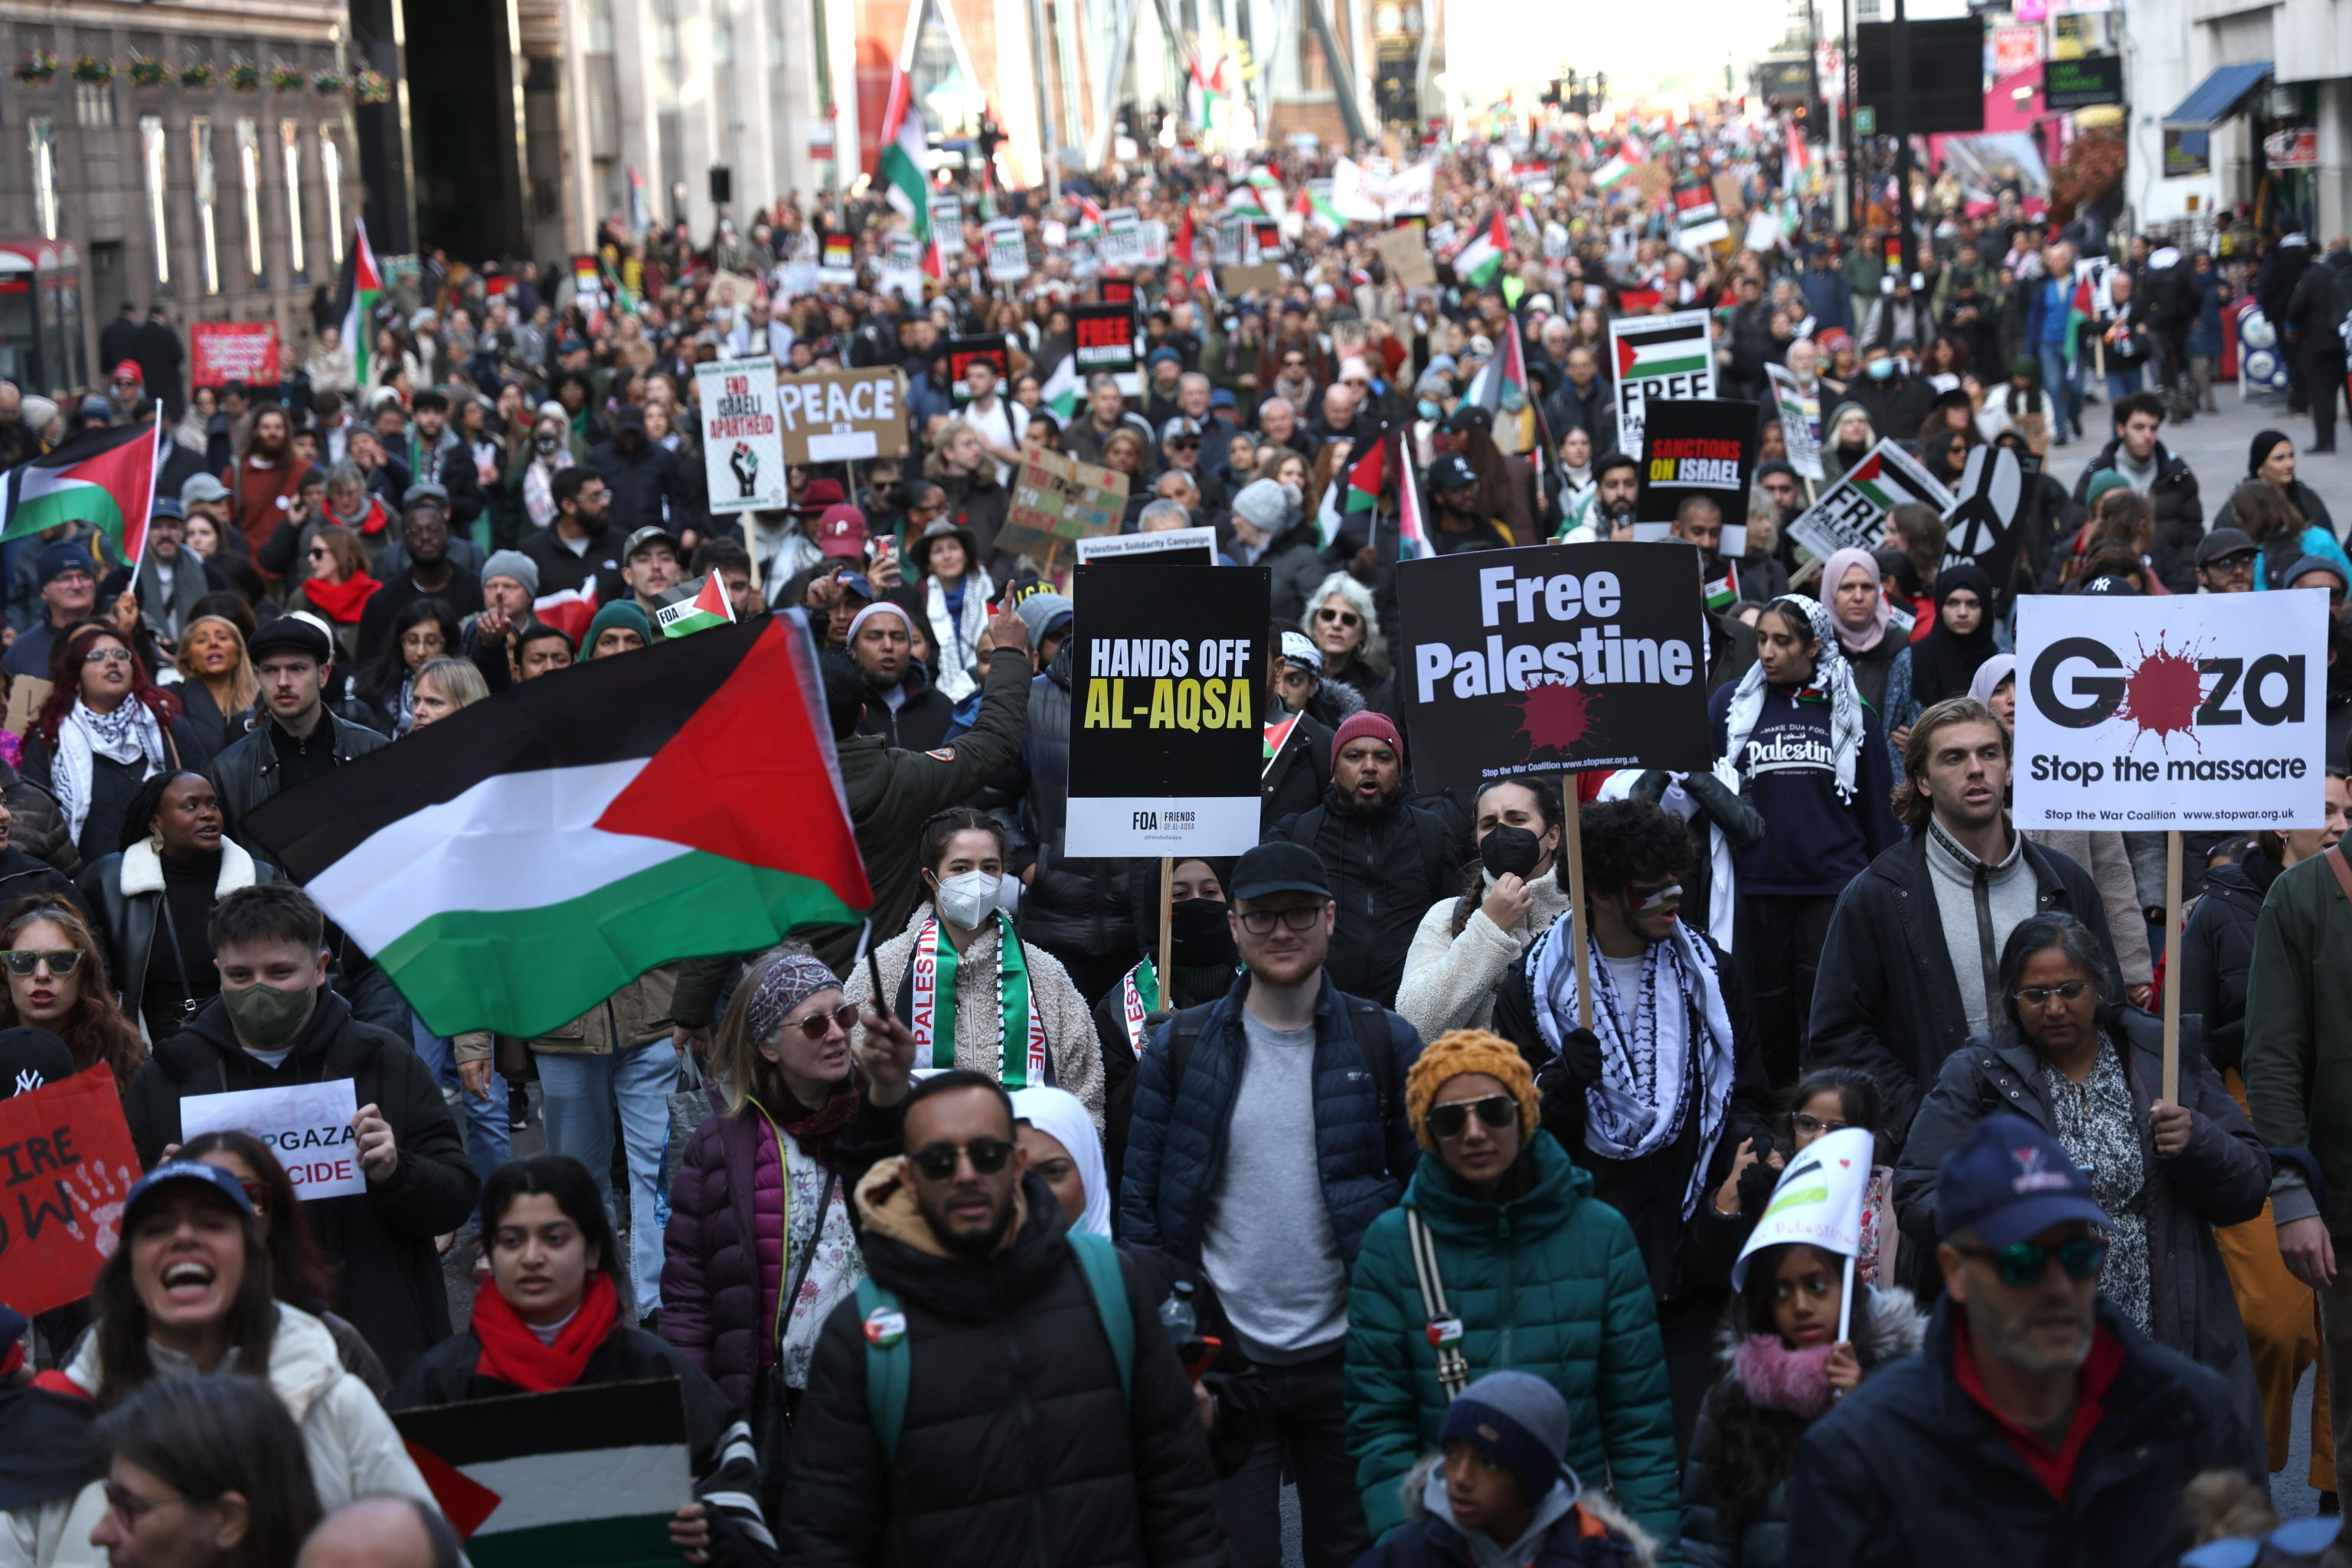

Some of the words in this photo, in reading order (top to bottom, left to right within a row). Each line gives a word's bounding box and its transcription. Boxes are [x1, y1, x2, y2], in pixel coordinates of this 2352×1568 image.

[1076, 316, 1132, 348] FREE
[1076, 345, 1133, 362] PALESTINE
[725, 376, 749, 396] END
[1621, 374, 1708, 414] FREE
[717, 394, 762, 417] ISRAELI
[779, 378, 895, 432] PEACE
[710, 413, 775, 439] APARTHEID
[1652, 439, 1742, 461] SANCTIONS
[1649, 459, 1676, 481] ON
[1678, 459, 1741, 483] ISRAEL
[1824, 484, 1885, 545] FRE
[1083, 543, 1122, 554] Palestine
[1125, 540, 1164, 550] Solidarity
[1167, 536, 1209, 546] Campaign
[1479, 566, 1621, 627] Free
[659, 607, 679, 624] FOA
[1090, 639, 1189, 678] HANDS
[1199, 639, 1251, 678] OFF
[1415, 624, 1694, 704] Palestine
[1083, 678, 1252, 733] AL-AQSA
[1765, 724, 1786, 733] MAKE
[1808, 725, 1825, 735] FOR
[1482, 767, 1498, 777] Stop
[1499, 766, 1511, 775] the
[1512, 765, 1526, 773] War
[1528, 761, 1560, 772] Coalition
[1563, 756, 1639, 769] www.stopwar.org.uk
[1746, 733, 1834, 779] Palestin
[2030, 754, 2104, 787] Stop
[2112, 755, 2159, 782] the
[2167, 757, 2307, 781] massacre
[1132, 812, 1158, 830] FOA
[1164, 812, 1195, 822] FRIENDS
[2045, 809, 2073, 822] Stop
[2076, 810, 2096, 820] the
[2099, 810, 2123, 820] War
[2127, 809, 2176, 820] Coalition
[2184, 808, 2294, 822] www.stopwar.org.uk
[914, 913, 938, 1046] PALESTIN
